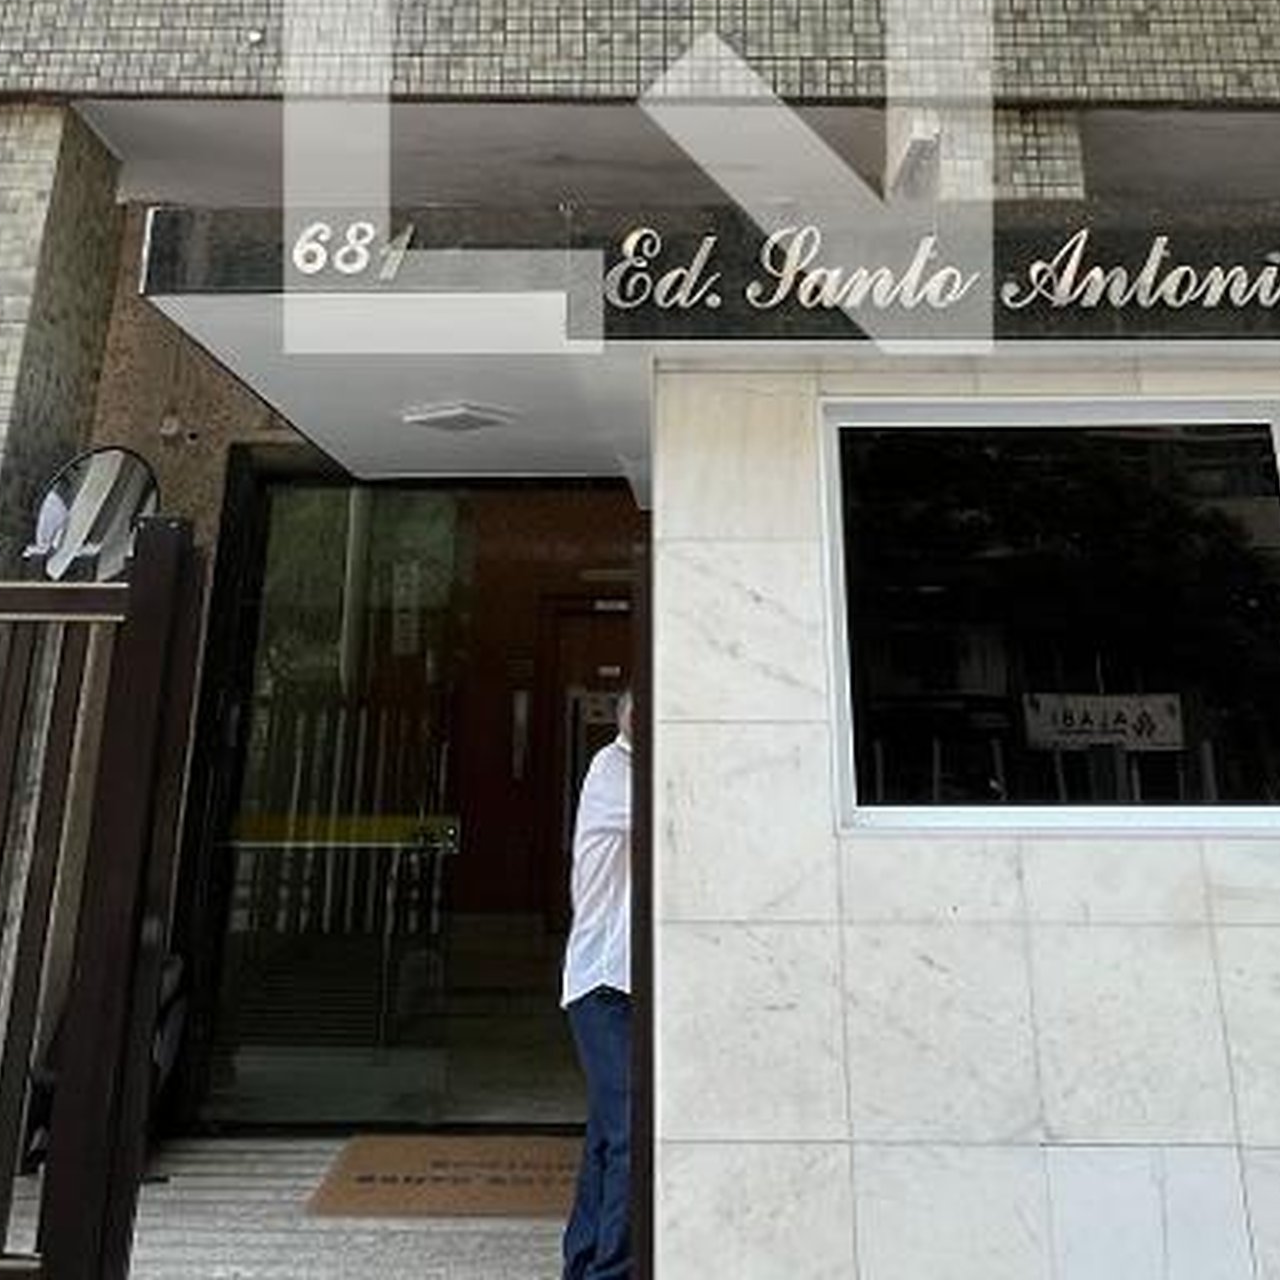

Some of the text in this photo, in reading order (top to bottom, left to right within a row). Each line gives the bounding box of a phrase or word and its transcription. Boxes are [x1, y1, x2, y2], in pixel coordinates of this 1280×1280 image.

[291, 221, 418, 280] 681
[603, 228, 722, 310] Ed.
[746, 226, 981, 311] Santo
